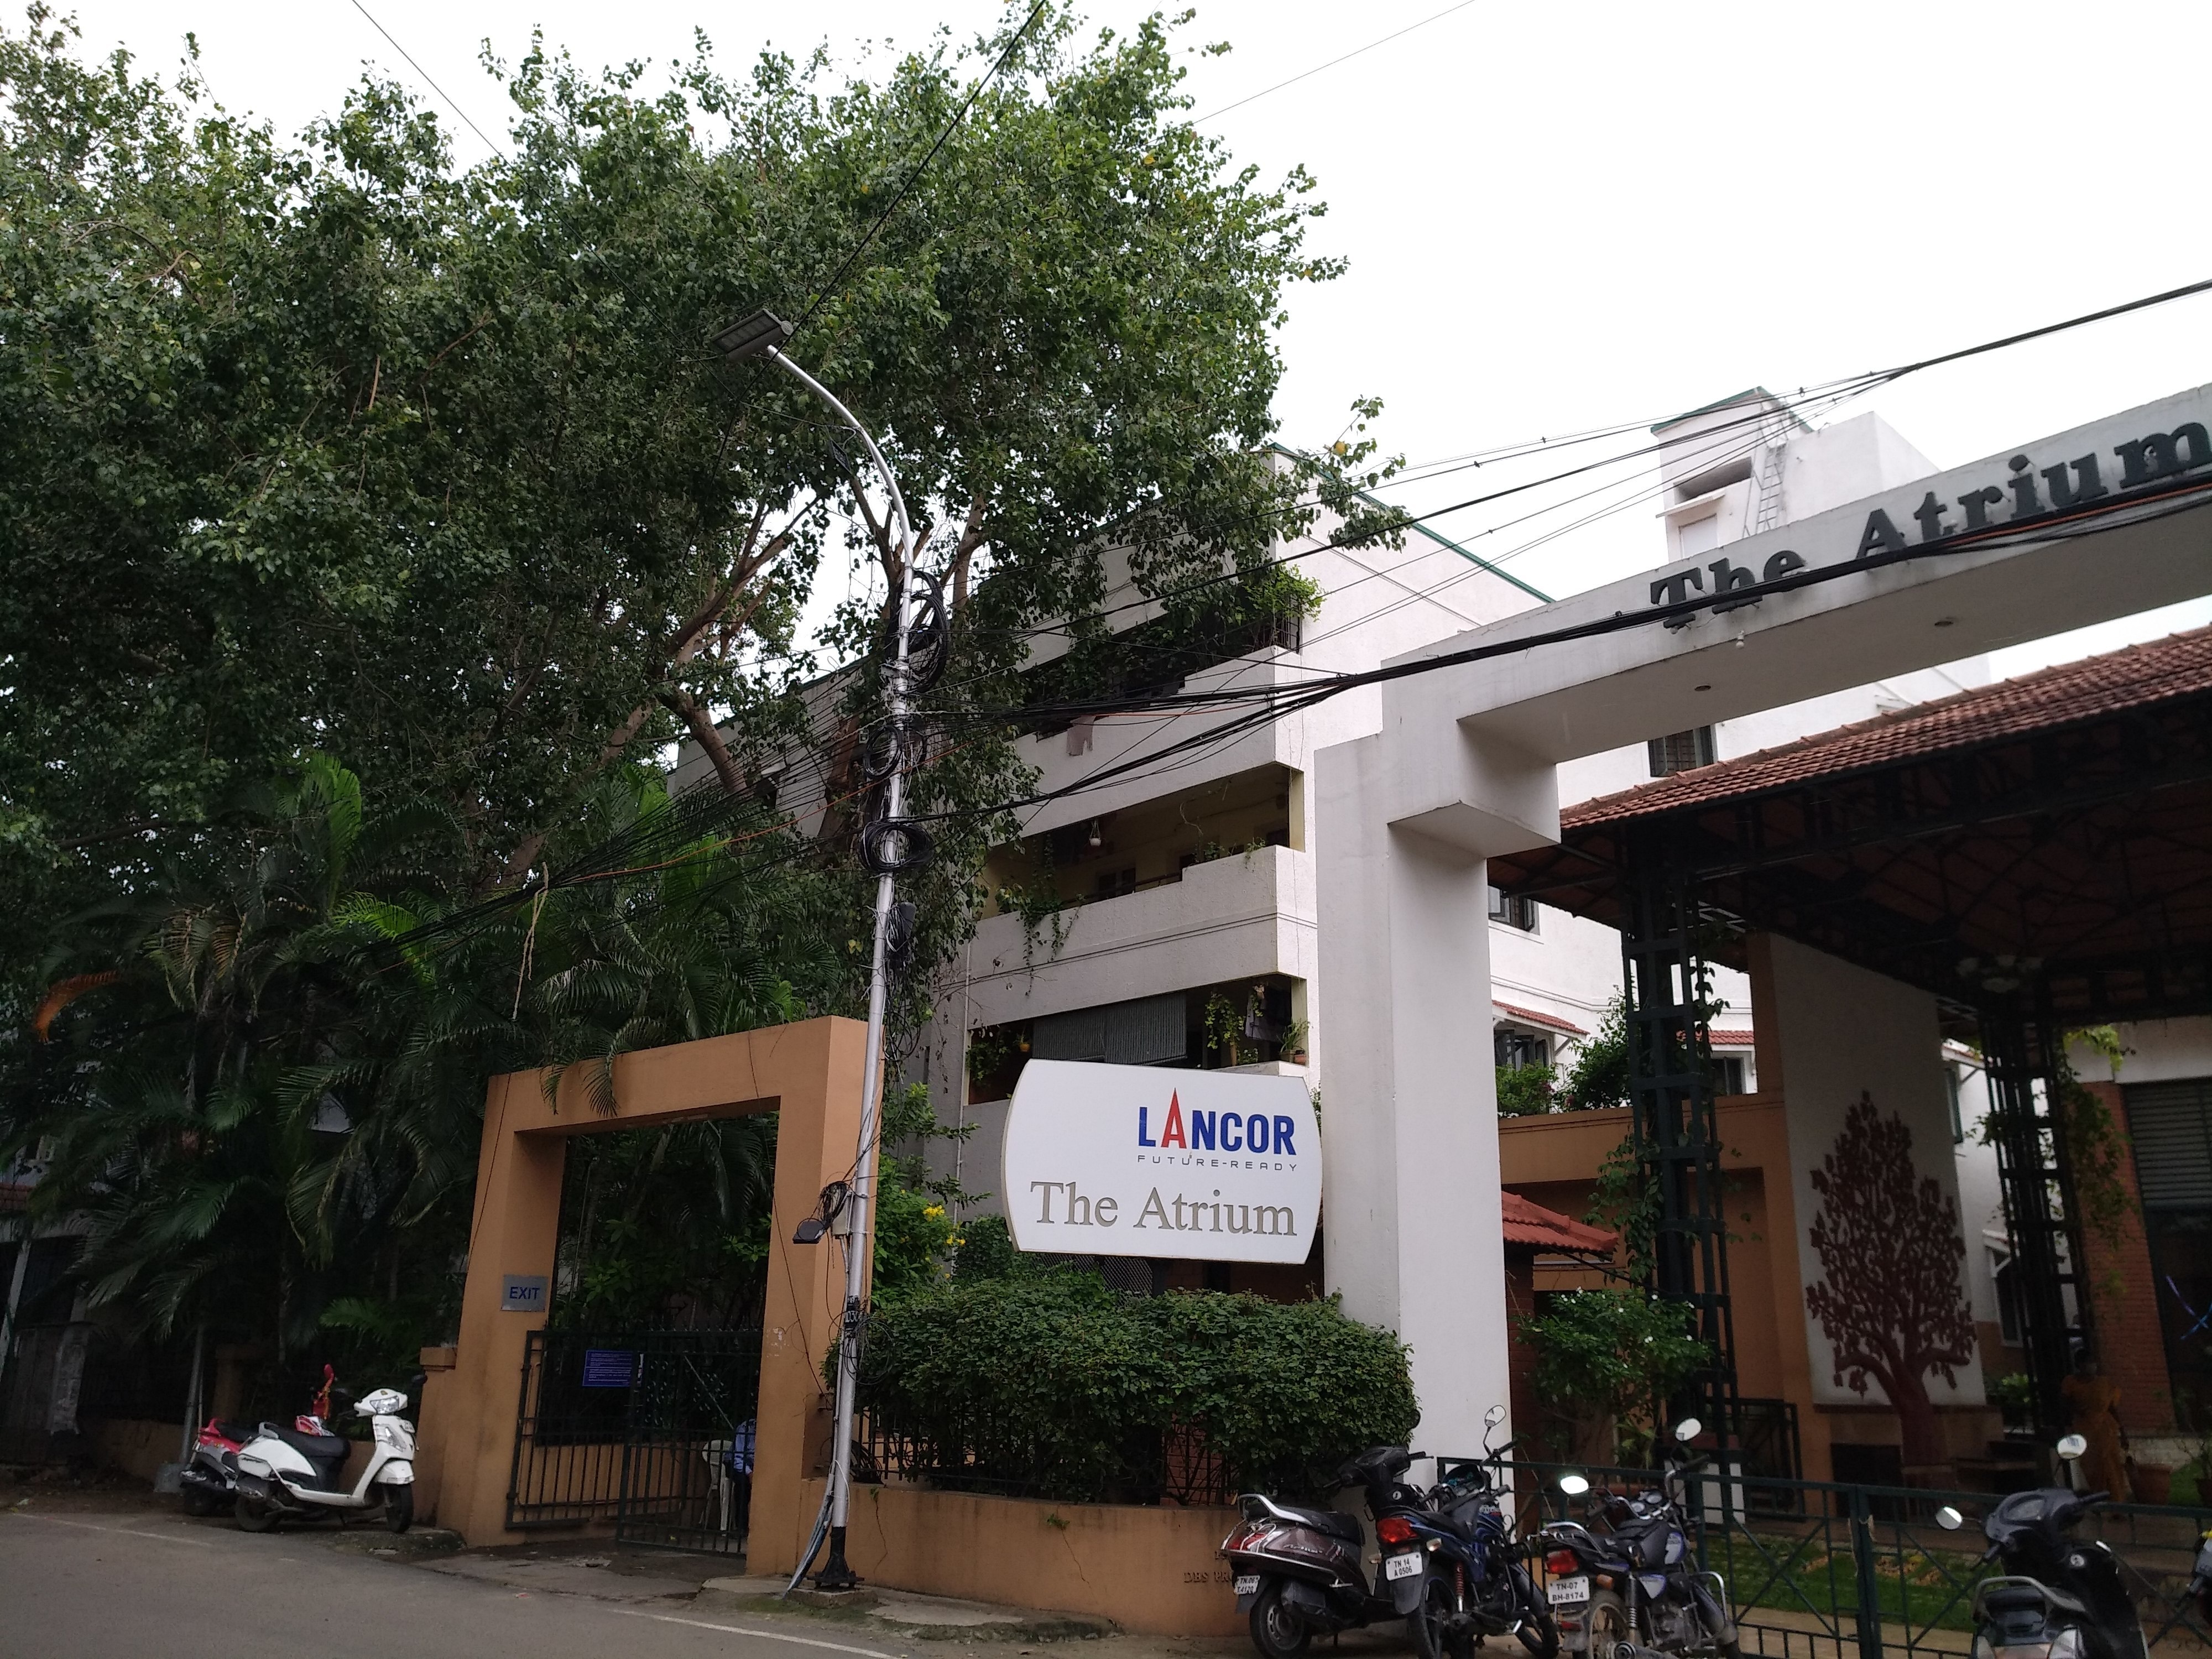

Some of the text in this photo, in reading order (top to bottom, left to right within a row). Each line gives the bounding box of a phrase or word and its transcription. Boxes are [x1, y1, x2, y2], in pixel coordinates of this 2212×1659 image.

[1650, 421, 2212, 628] The Atrium
[1138, 1088, 1297, 1156] LANCOR
[1137, 1155, 1297, 1172] FUTURE-READY
[1030, 1181, 1298, 1237] The Atrium
[509, 1286, 540, 1300] EXIT
[1394, 1559, 1402, 1568] TN
